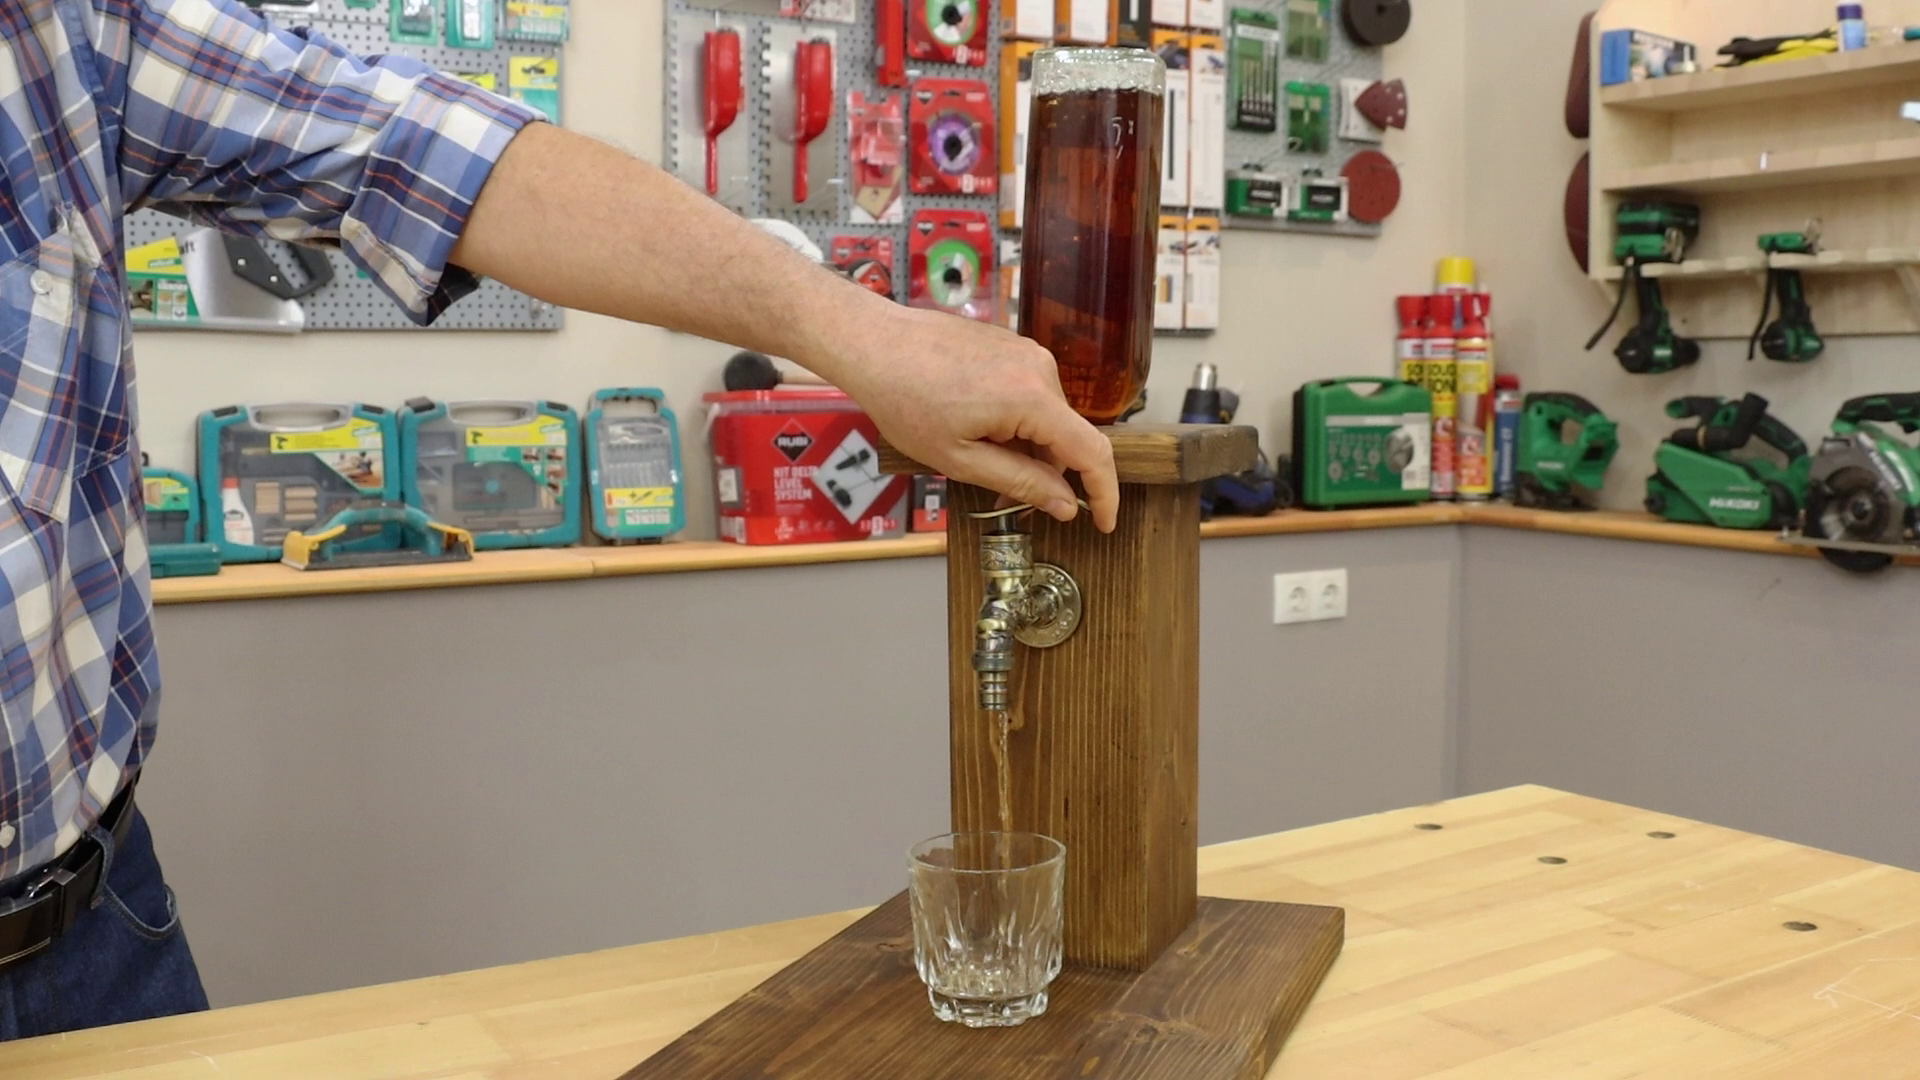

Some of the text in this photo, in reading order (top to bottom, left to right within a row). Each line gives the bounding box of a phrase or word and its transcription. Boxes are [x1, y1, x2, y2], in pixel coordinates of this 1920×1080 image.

[777, 435, 809, 448] RUBI
[773, 466, 790, 479] KIT
[773, 477, 803, 489] LEVEL
[773, 488, 813, 501] SYSTEM
